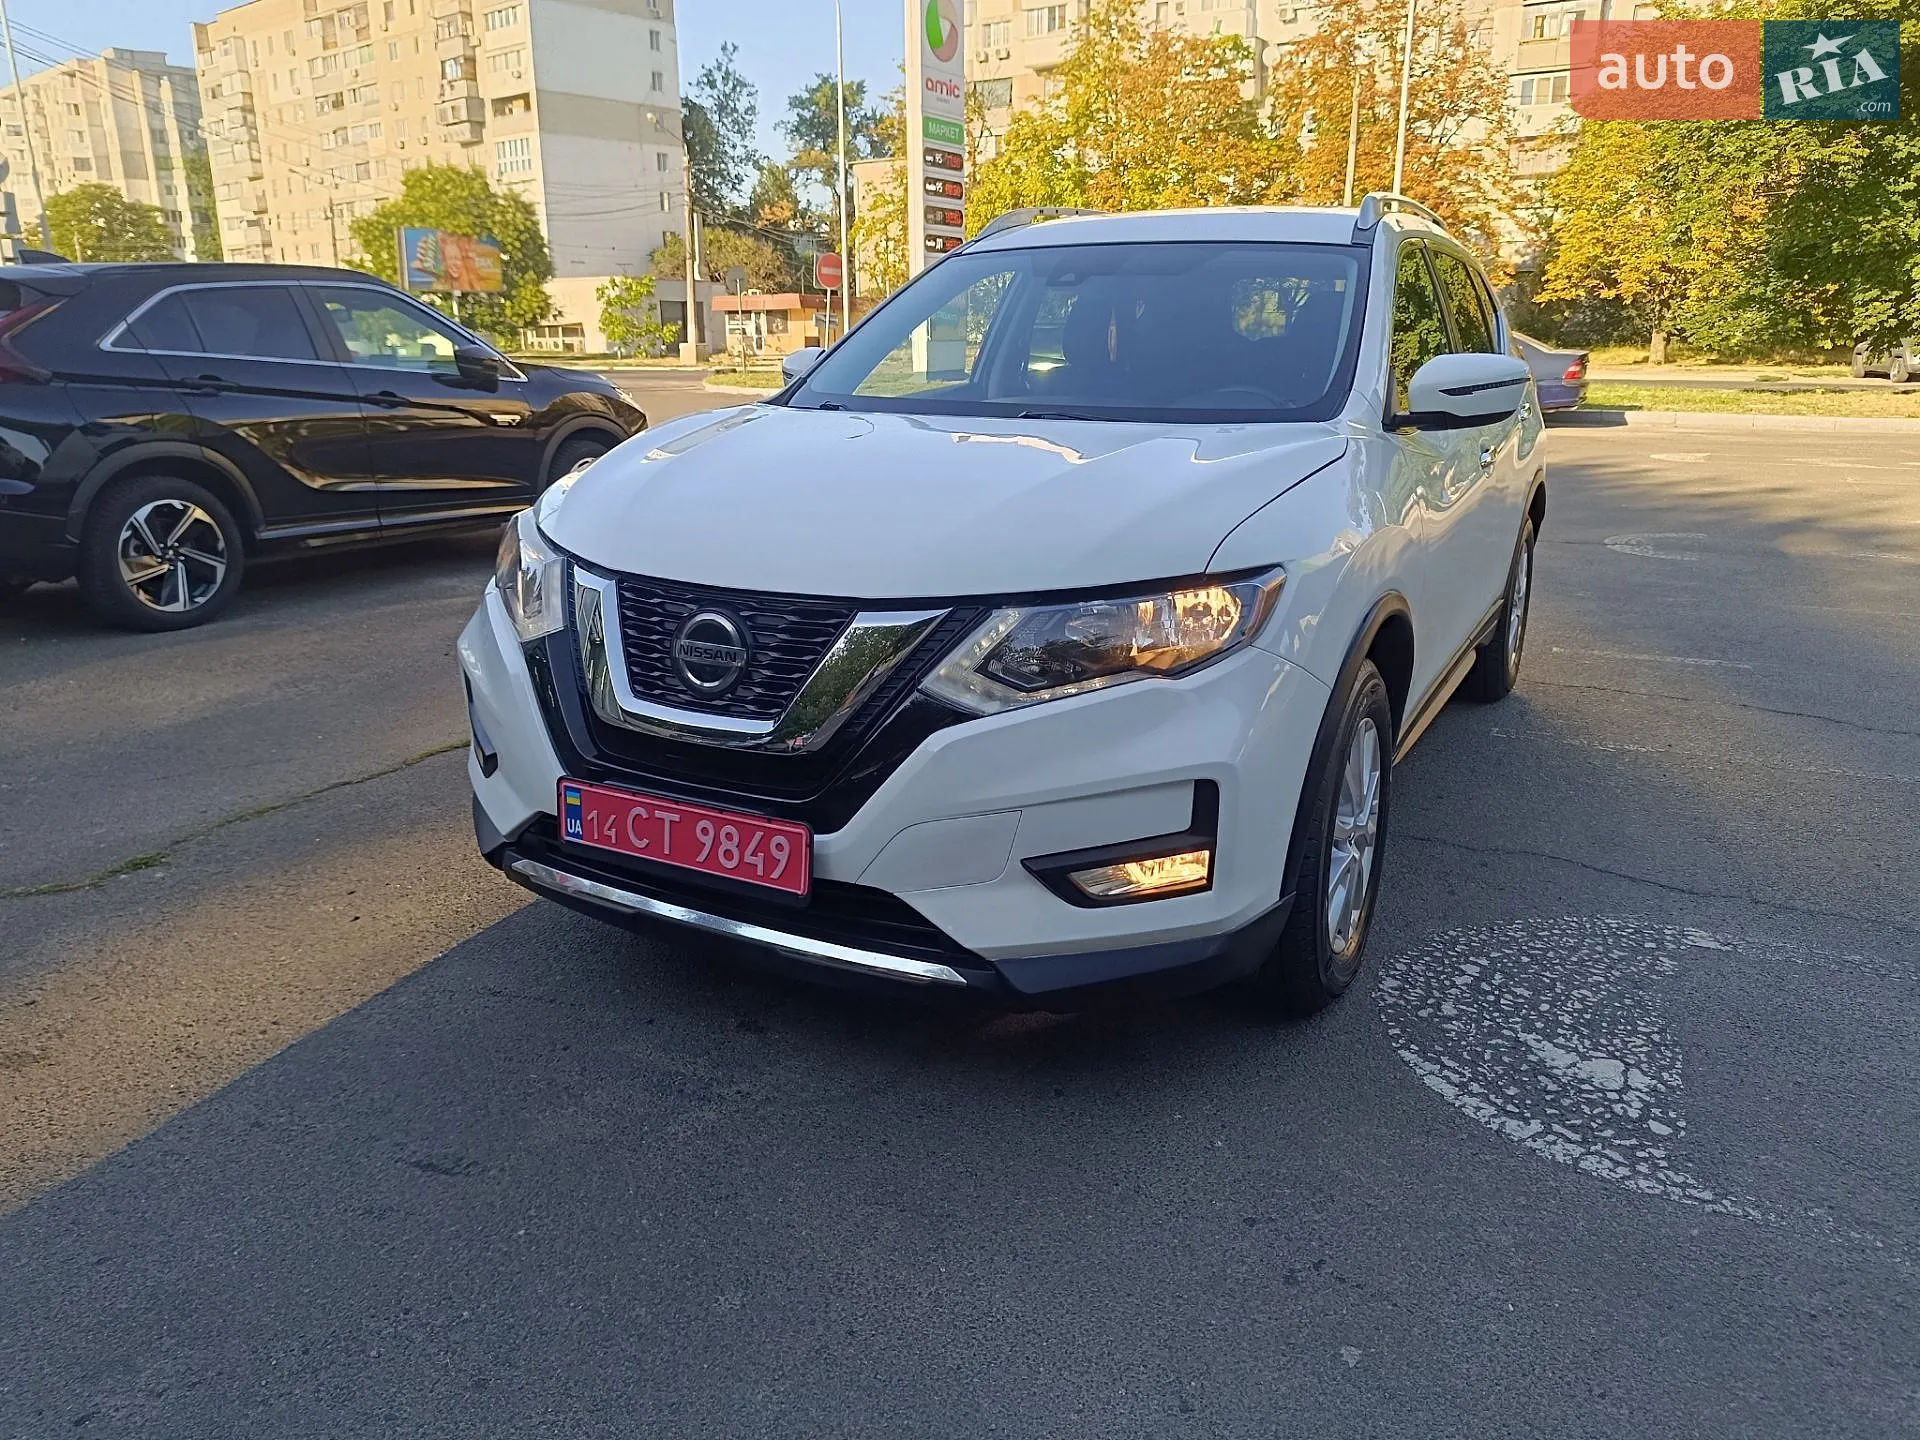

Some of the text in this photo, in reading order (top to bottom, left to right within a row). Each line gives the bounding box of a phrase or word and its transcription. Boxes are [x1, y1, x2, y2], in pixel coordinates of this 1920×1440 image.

[926, 78, 960, 98] amic
[680, 644, 737, 662] NISSAN
[567, 818, 582, 835] UA
[695, 819, 790, 880] 9849
